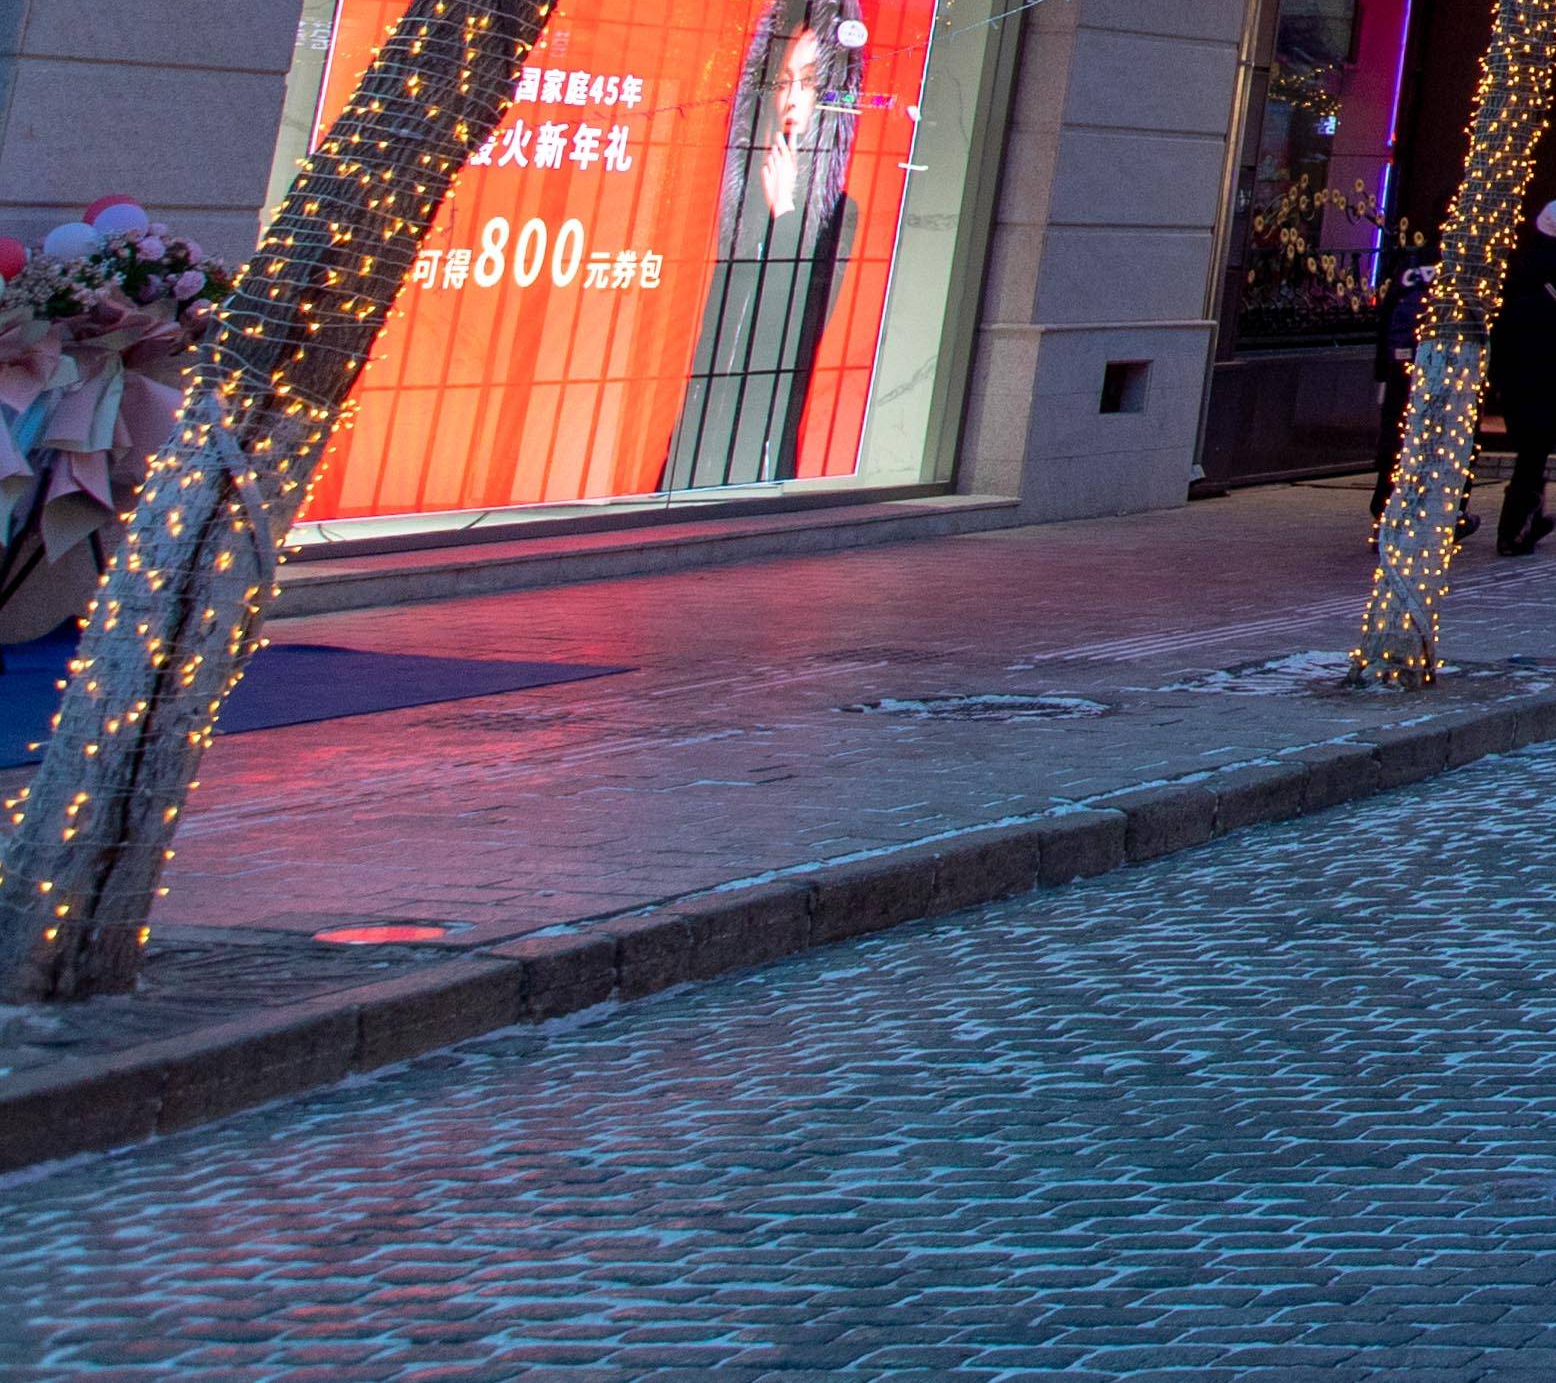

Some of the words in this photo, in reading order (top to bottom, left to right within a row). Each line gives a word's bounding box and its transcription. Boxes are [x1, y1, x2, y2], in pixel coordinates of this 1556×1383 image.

[411, 216, 664, 289] 可得800元券包
